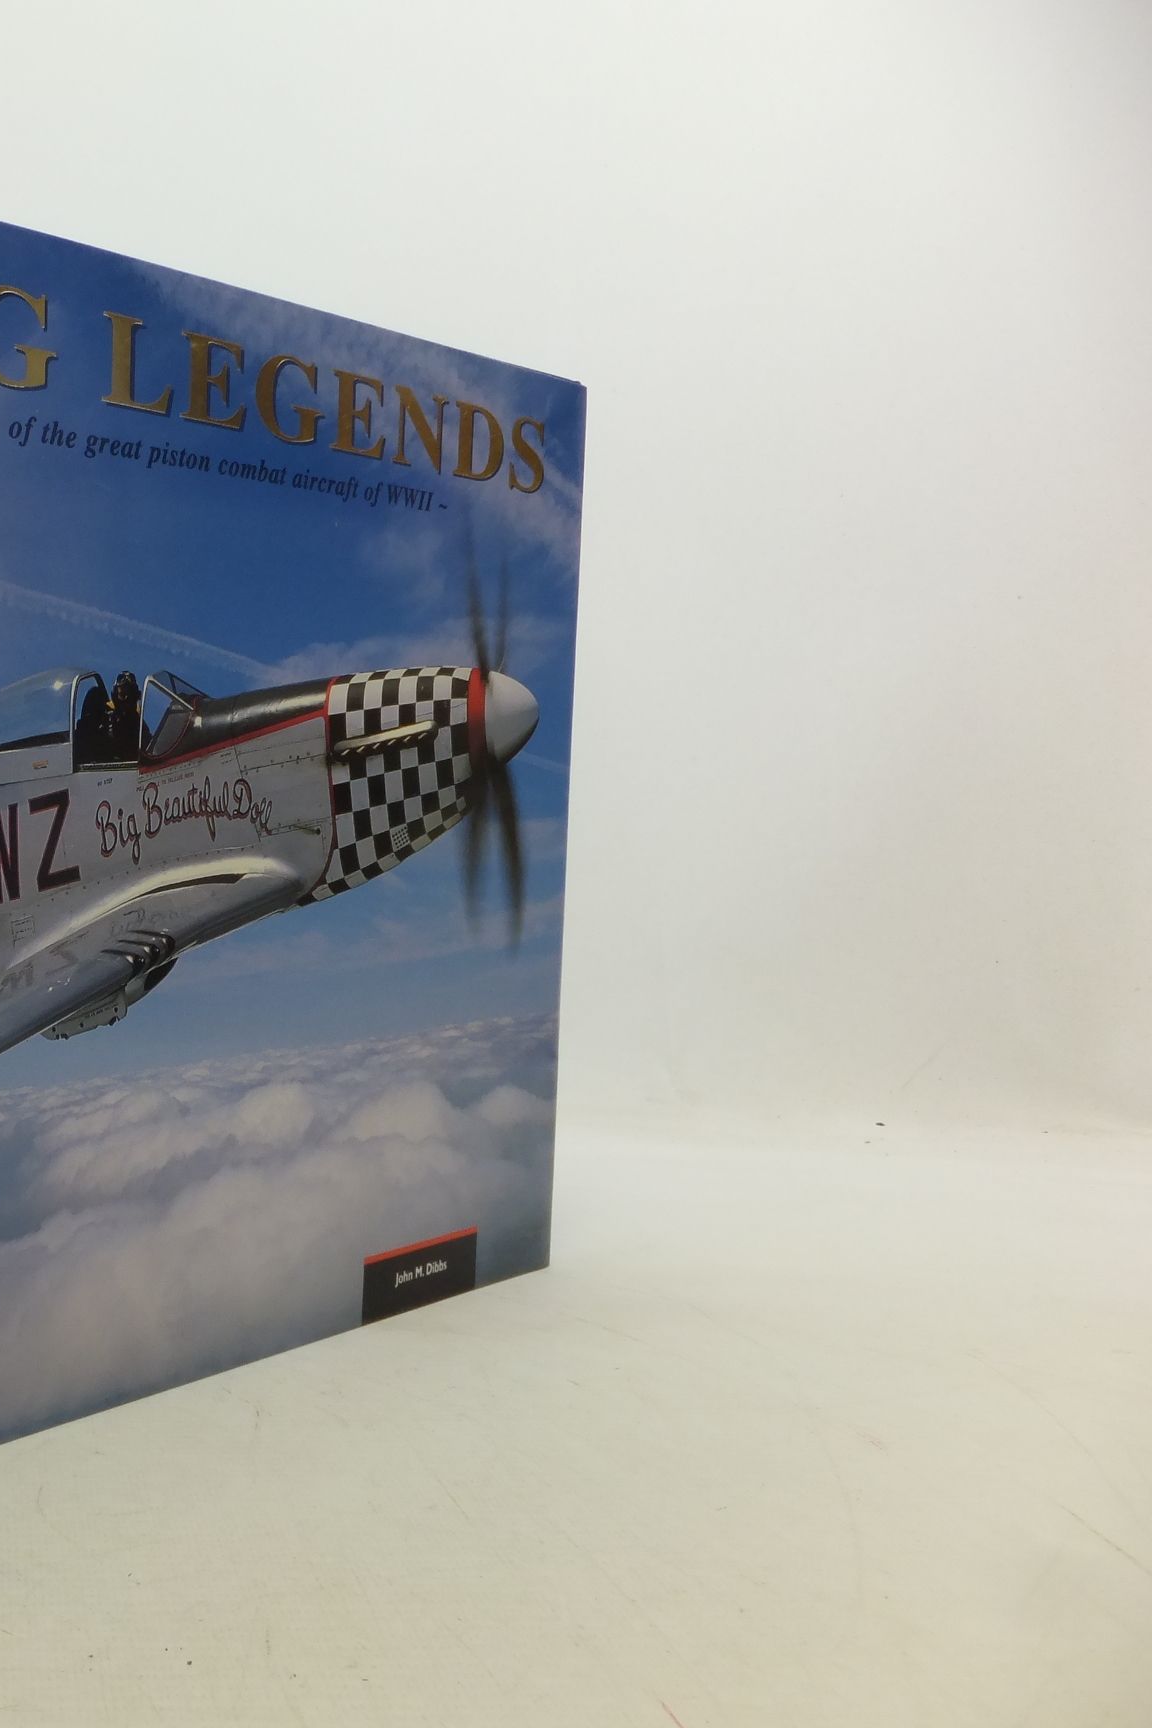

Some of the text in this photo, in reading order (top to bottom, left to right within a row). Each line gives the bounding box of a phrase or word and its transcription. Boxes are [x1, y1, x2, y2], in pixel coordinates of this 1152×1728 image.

[101, 310, 547, 495] LEGENDS
[8, 416, 38, 447] of
[41, 421, 78, 449] the
[84, 434, 143, 459] great
[147, 441, 210, 469] piston
[218, 458, 288, 486] combat
[291, 469, 360, 504] aircraft
[364, 481, 385, 508] of
[387, 484, 435, 513] WWII
[96, 775, 274, 865] Big Beautiful Doll
[394, 1259, 448, 1288] John M. Dibbs
